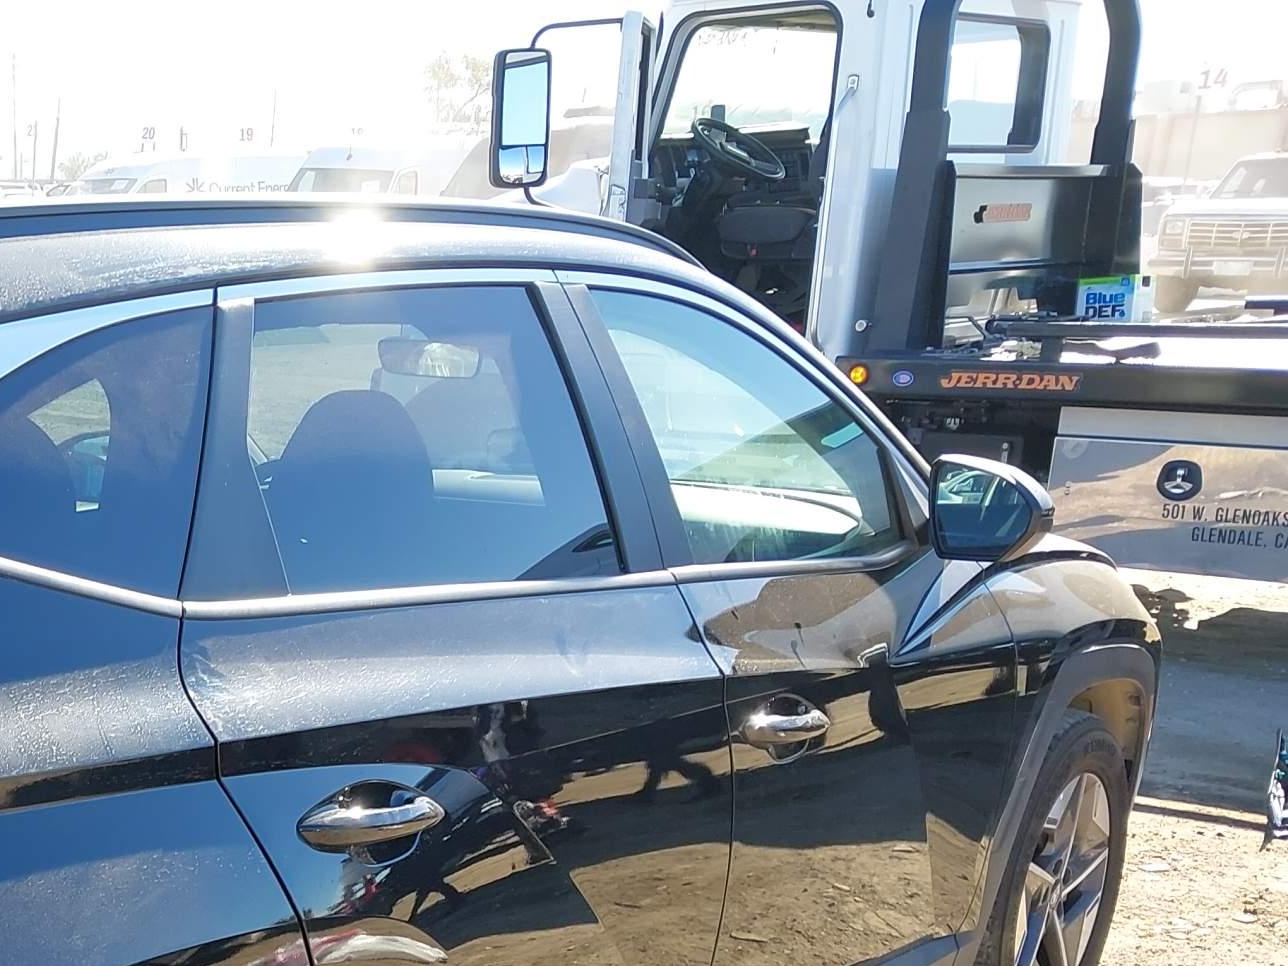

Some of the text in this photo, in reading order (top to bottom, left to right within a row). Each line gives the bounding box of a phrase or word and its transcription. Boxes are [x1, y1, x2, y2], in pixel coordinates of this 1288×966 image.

[1198, 68, 1228, 90] 14
[142, 126, 155, 140] 20
[240, 127, 253, 141] 19
[1085, 292, 1125, 304] Blue
[1085, 304, 1125, 319] DEF
[1162, 503, 1288, 528] 501 W. GLENOAKS
